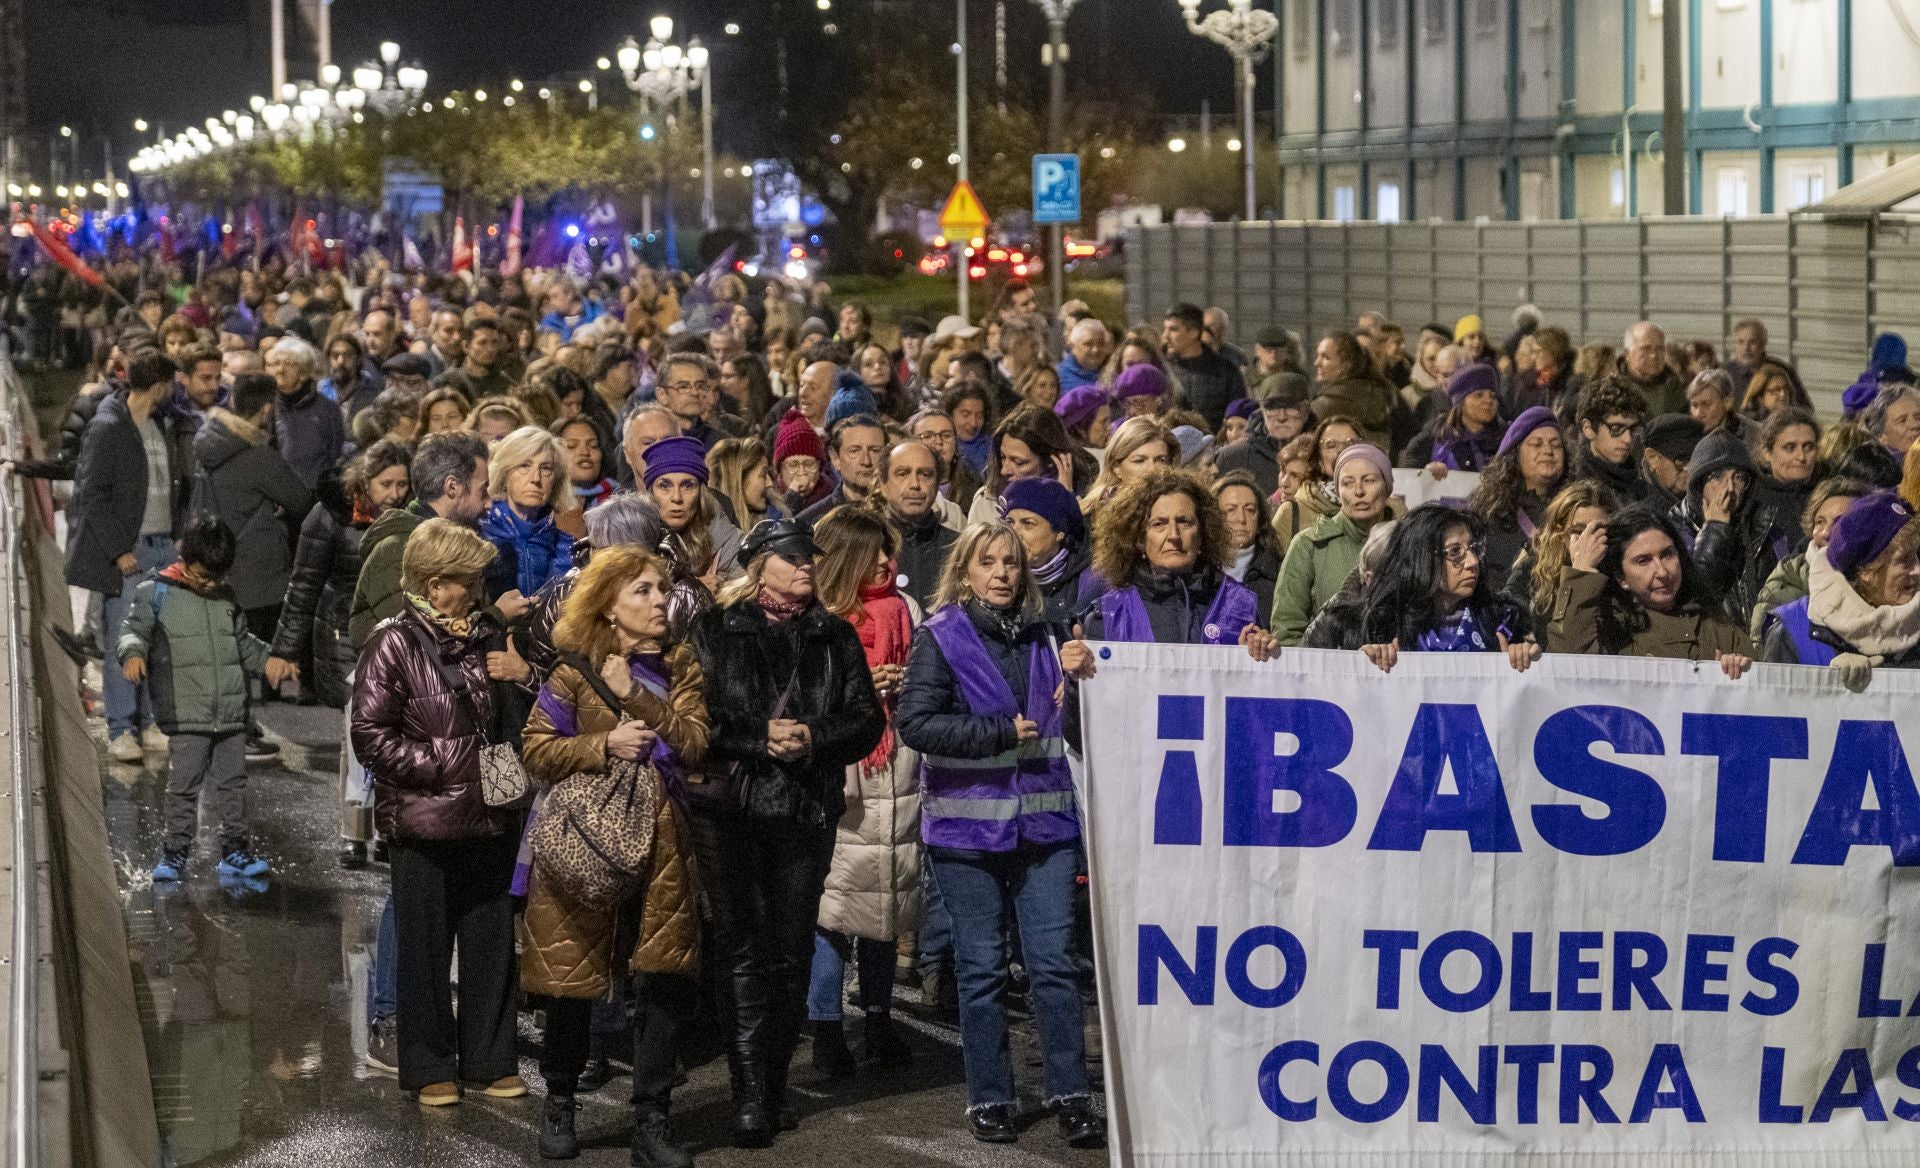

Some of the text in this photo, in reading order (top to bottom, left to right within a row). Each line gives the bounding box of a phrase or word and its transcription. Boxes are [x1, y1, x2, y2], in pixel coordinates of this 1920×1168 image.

[1038, 161, 1065, 195] P
[1153, 695, 1920, 868] ¡BASTA
[1137, 924, 1920, 1018] NO TOLERES L
[1258, 1040, 1706, 1124] CONTRA
